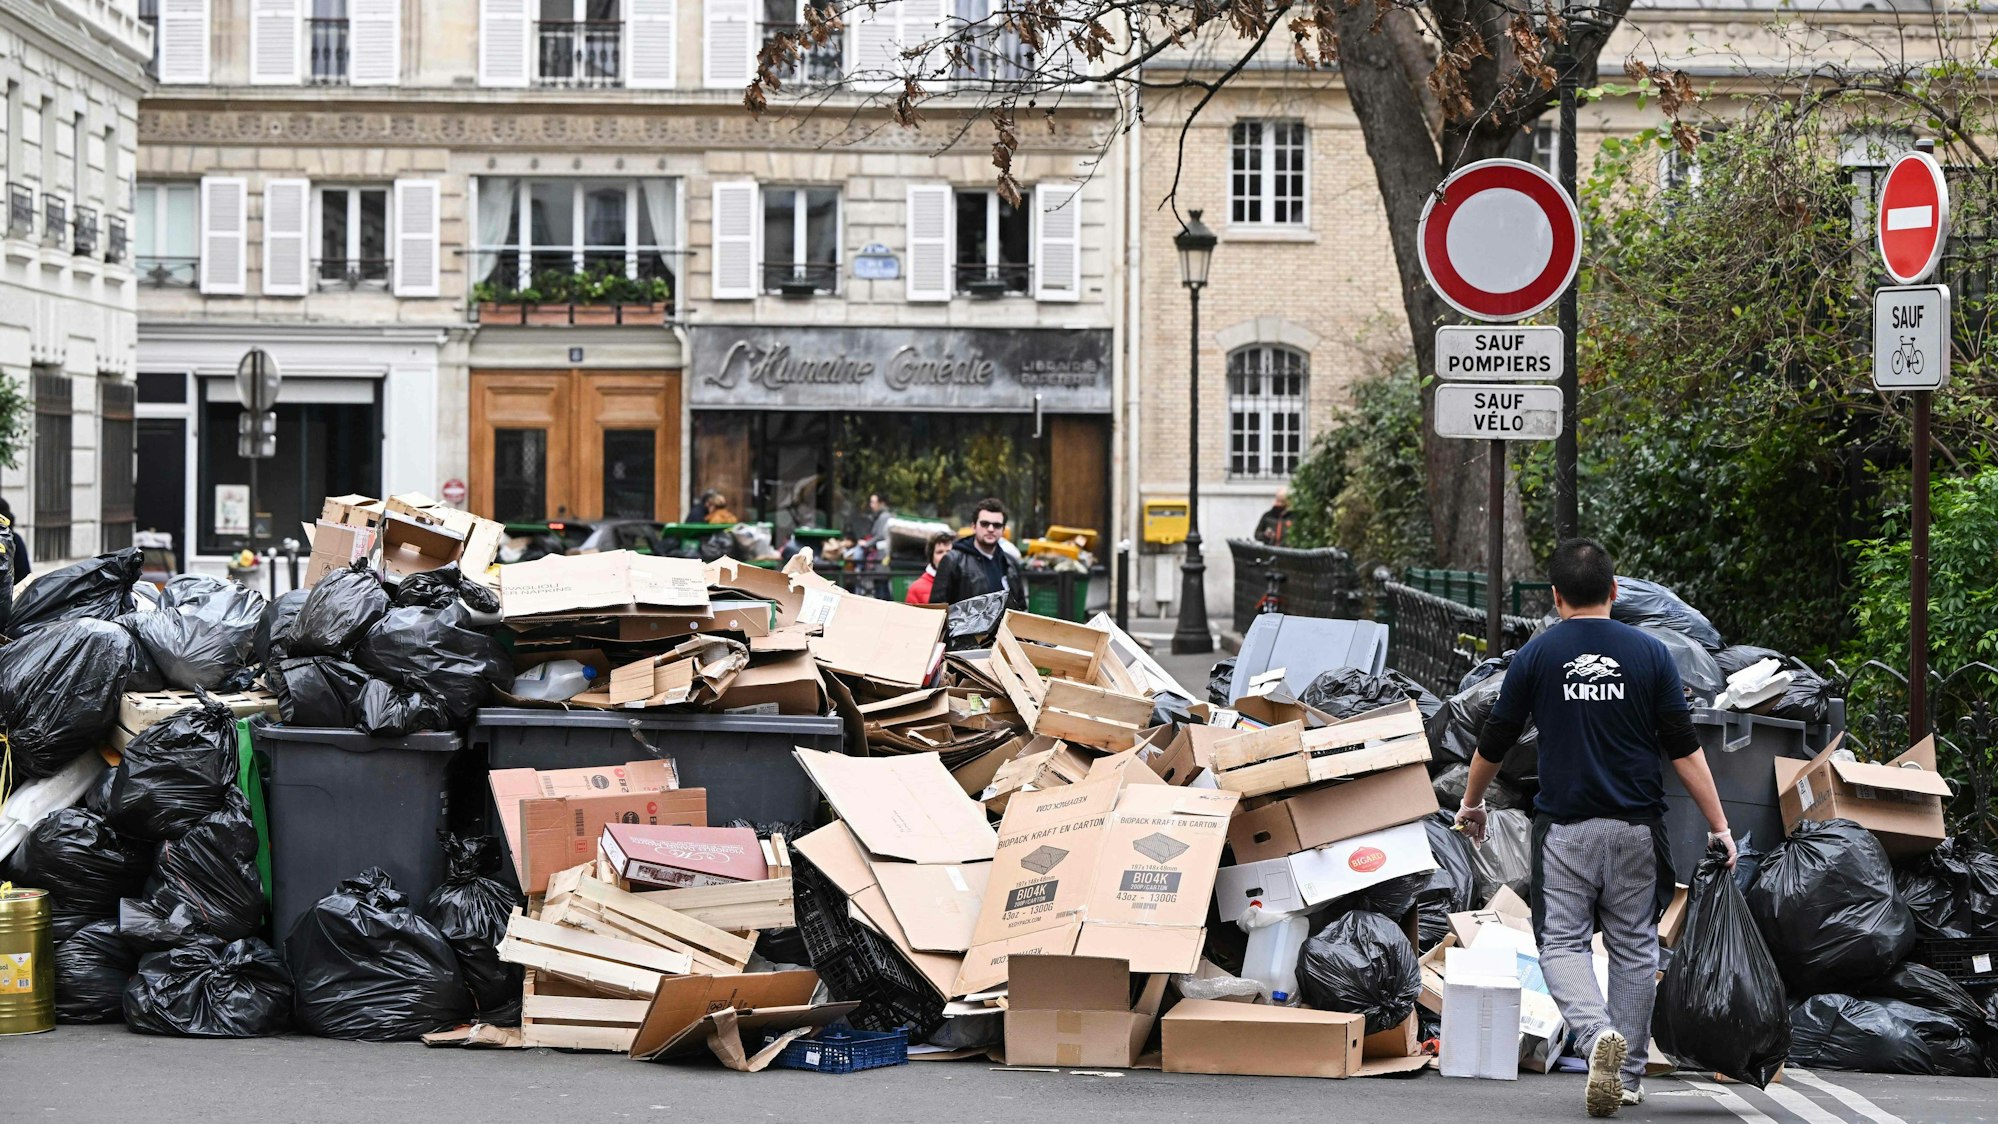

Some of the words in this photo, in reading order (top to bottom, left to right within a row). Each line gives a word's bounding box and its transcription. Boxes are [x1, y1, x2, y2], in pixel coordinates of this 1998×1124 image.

[1892, 305, 1924, 328] SAUF
[1475, 334, 1525, 350] SAUF
[704, 340, 875, 390] L'Humaine
[884, 345, 993, 390] Comédie
[1449, 356, 1551, 372] POMPIERS
[1474, 393, 1524, 410] SAUF
[1474, 410, 1524, 431] VÉLO
[521, 586, 572, 595] NAPKINS
[1563, 682, 1624, 700] KIRIN
[1036, 796, 1088, 812] KEDYPACK.COM
[1120, 816, 1150, 825] BIOPACK
[1152, 818, 1175, 826] KRAFT
[998, 834, 1028, 850] BIOPACK
[1031, 826, 1058, 840] KRAFT
[1060, 824, 1072, 834] EN
[1072, 817, 1106, 831] CARTON
[1351, 852, 1383, 868] BIGARD
[1116, 892, 1137, 901] 43oz
[1150, 894, 1177, 902] 1300G
[1002, 911, 1020, 920] 43oz
[1030, 902, 1054, 914] 1300G
